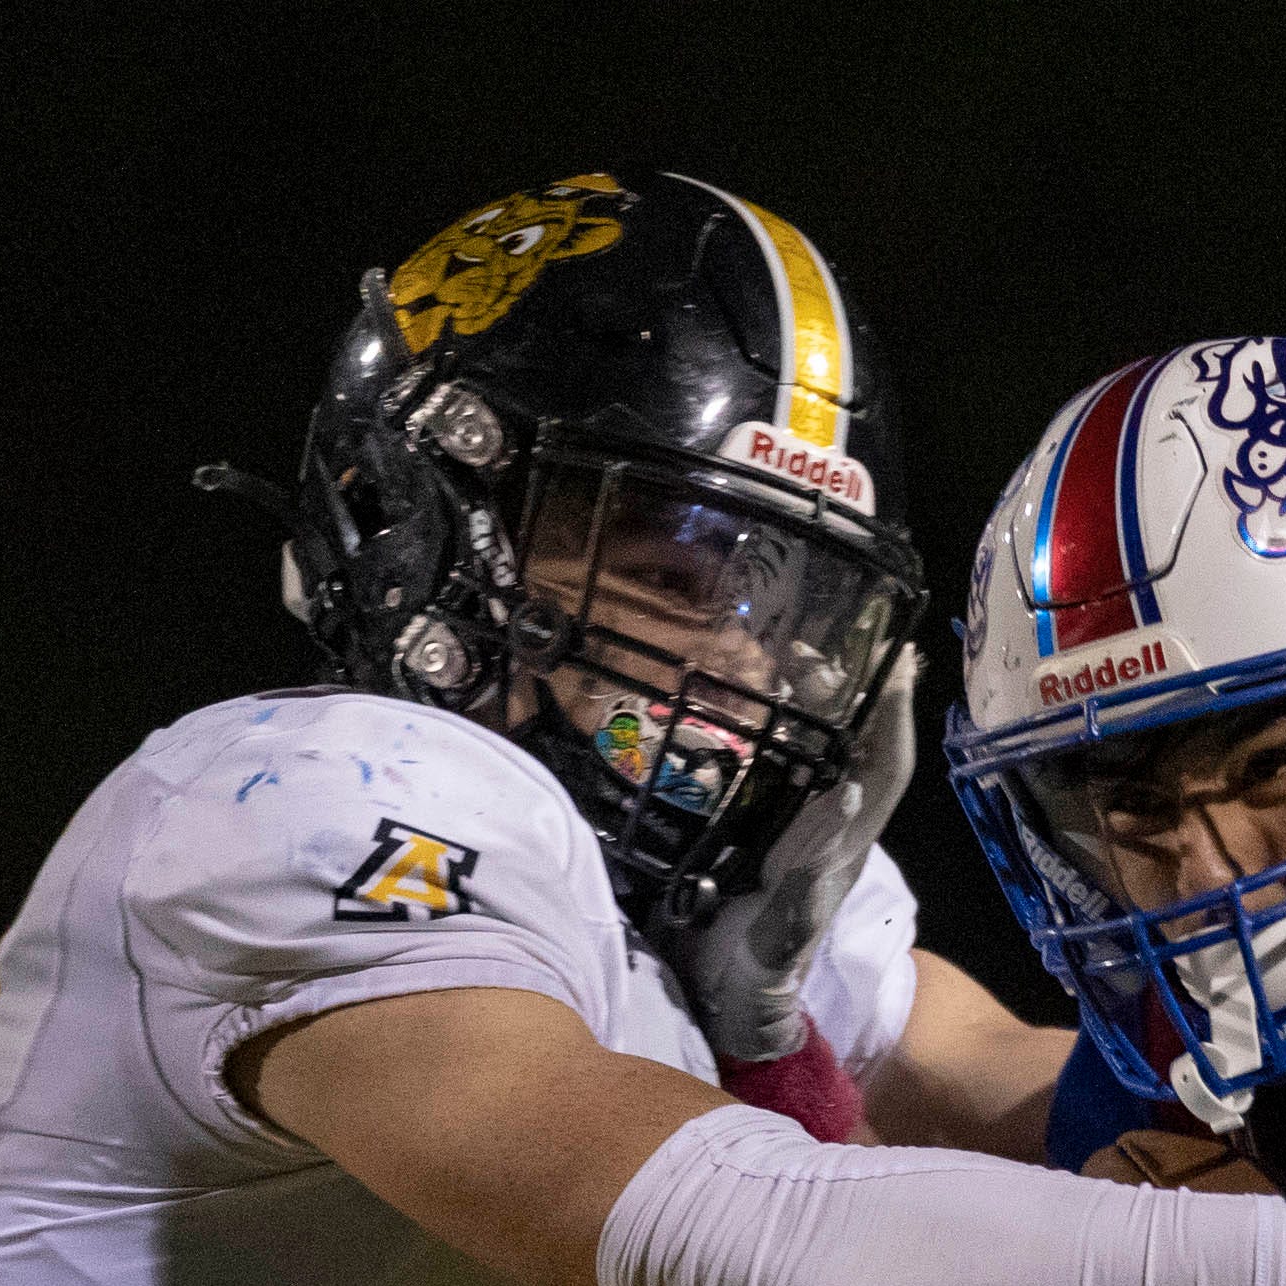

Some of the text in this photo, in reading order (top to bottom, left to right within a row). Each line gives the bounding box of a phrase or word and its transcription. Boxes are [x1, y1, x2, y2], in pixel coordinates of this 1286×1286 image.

[750, 430, 862, 500] Riddell
[1039, 640, 1167, 706] Riddell
[333, 817, 480, 922] A
